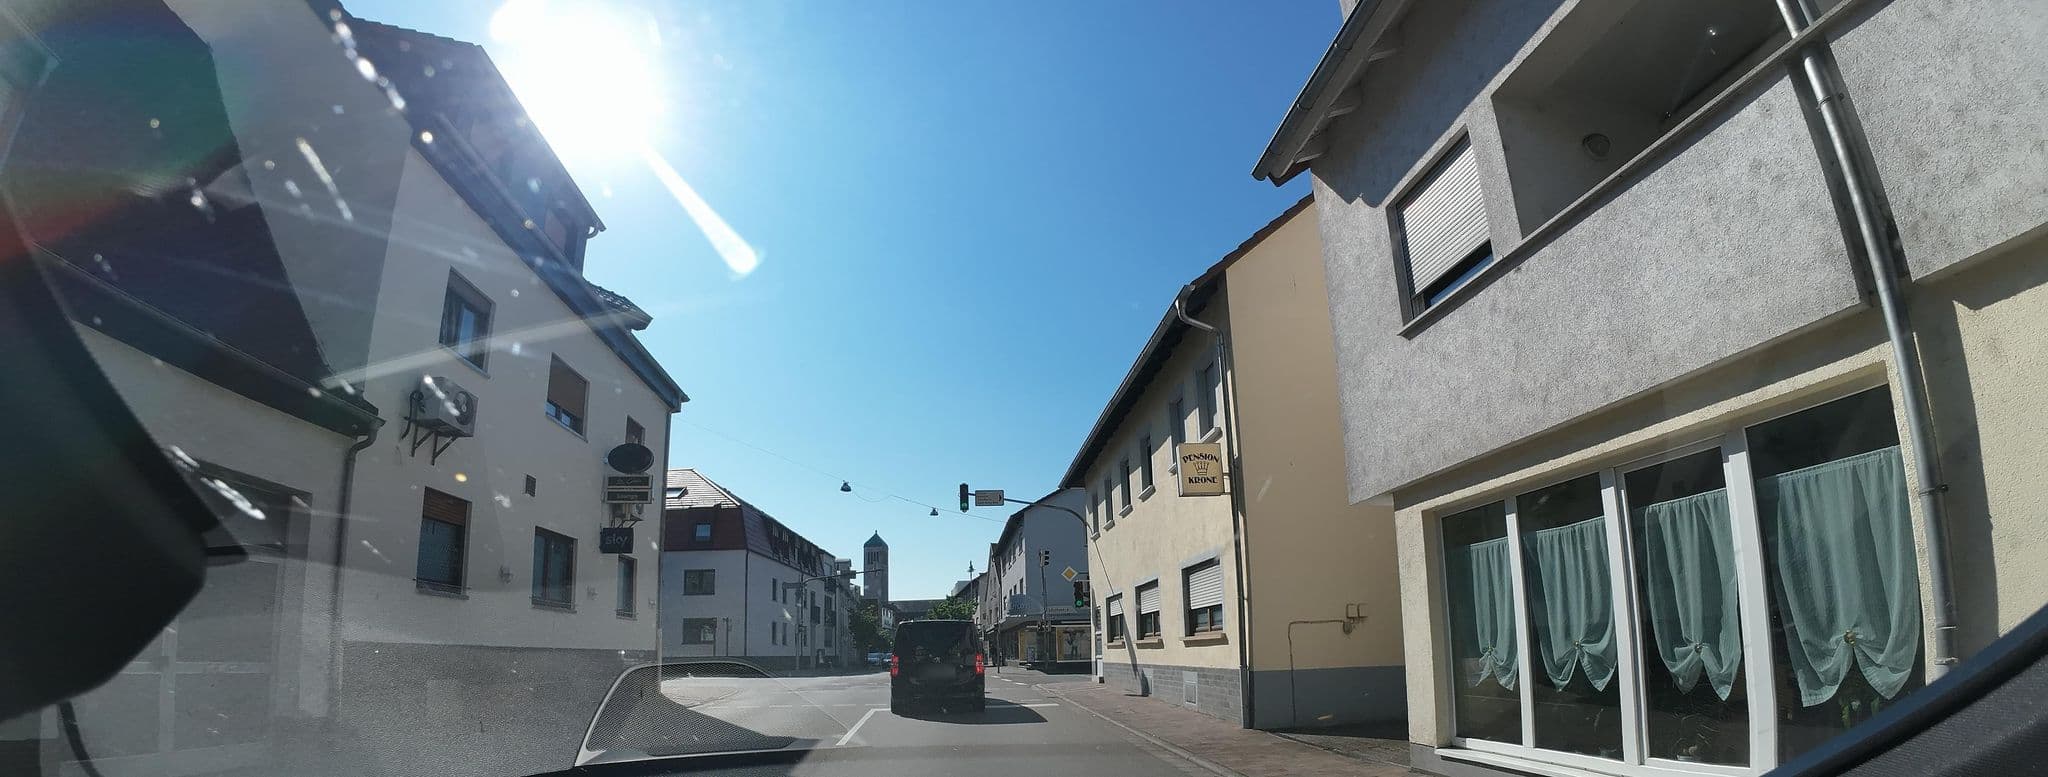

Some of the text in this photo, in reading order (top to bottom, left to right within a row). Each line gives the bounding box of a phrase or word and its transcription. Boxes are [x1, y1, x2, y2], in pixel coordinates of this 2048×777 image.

[1182, 453, 1219, 464] PENSION
[1188, 476, 1218, 484] KRONE
[605, 533, 628, 548] sky
